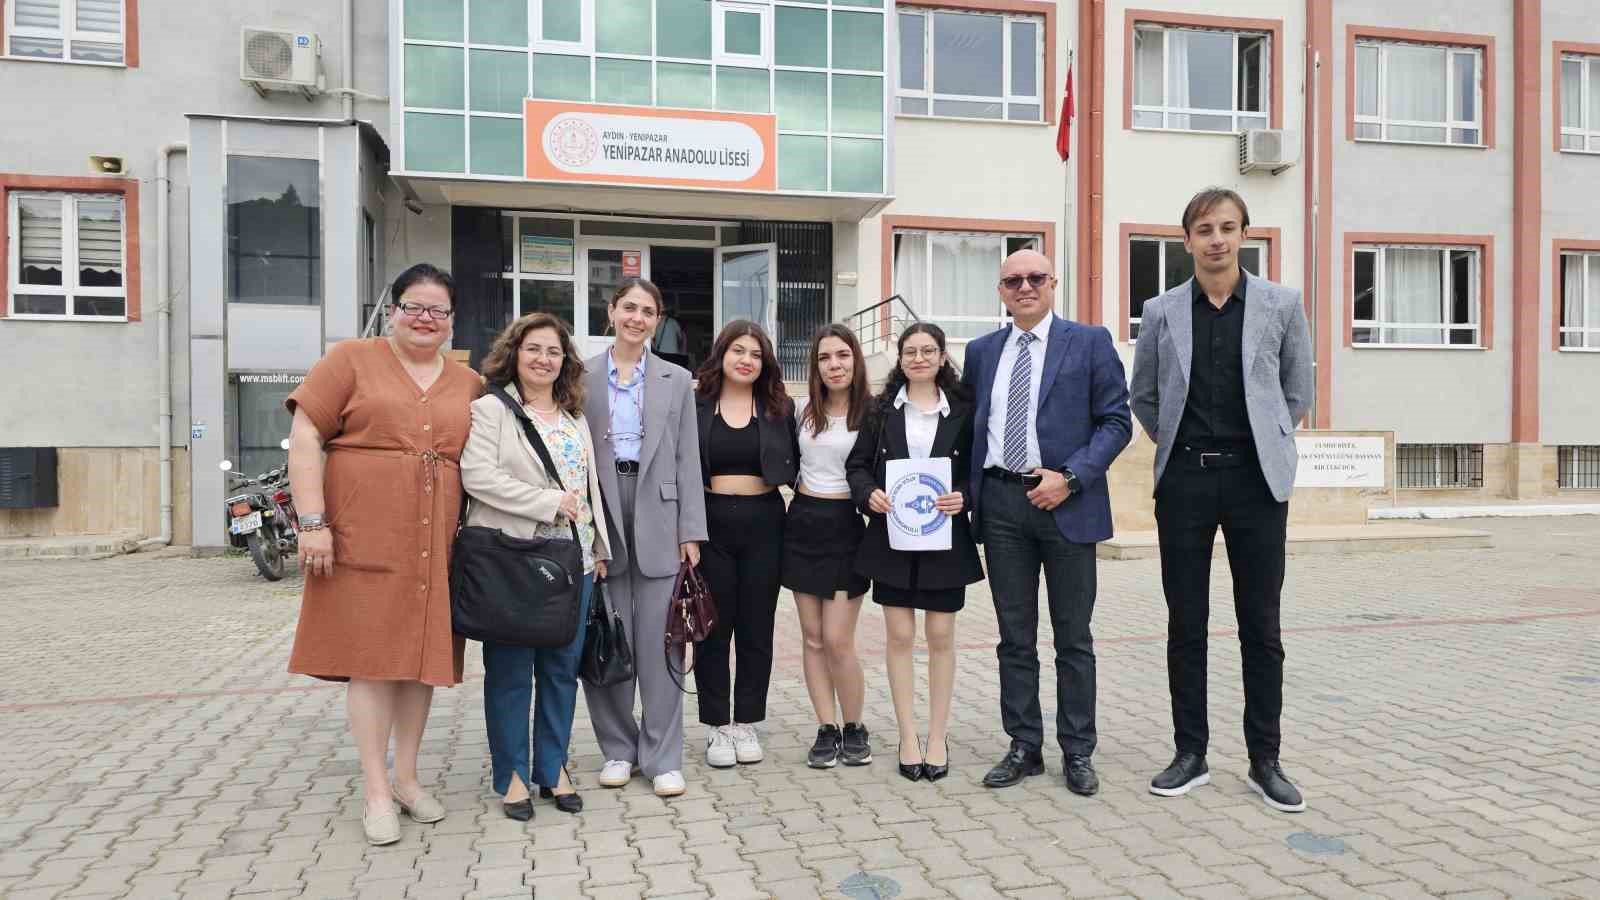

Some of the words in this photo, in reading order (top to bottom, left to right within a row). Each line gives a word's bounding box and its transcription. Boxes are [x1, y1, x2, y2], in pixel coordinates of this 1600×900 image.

[602, 131, 624, 140] AYDIN
[602, 143, 663, 162] YENİPAZAR
[665, 148, 717, 165] ANADOLU
[719, 148, 750, 167] LİSESİ
